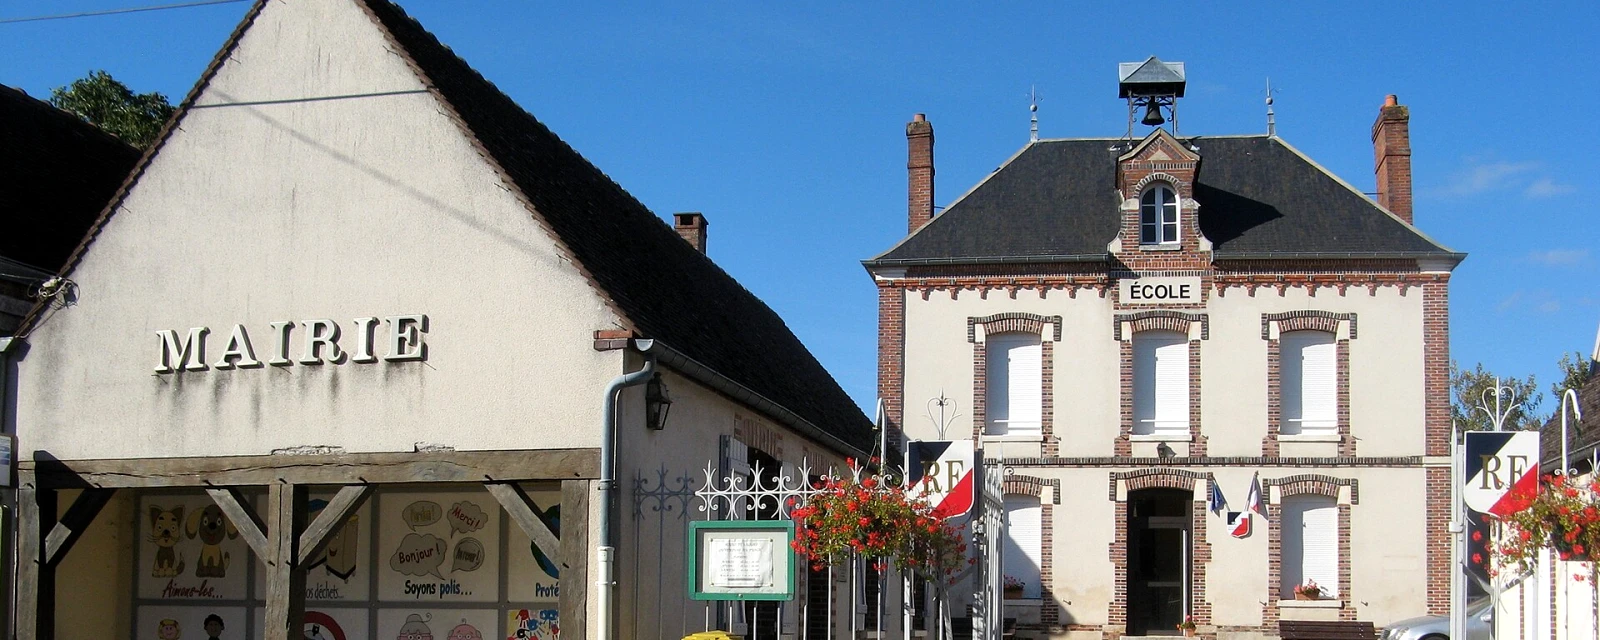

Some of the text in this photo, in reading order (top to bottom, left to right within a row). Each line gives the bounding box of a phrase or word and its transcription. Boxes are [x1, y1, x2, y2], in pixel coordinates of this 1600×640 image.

[1130, 281, 1191, 300] ÉCOLE
[154, 314, 429, 374] MAIRIE
[920, 460, 963, 494] RF
[1479, 455, 1528, 490] RF
[398, 548, 434, 564] Bonjour
[404, 580, 436, 598] Soyons
